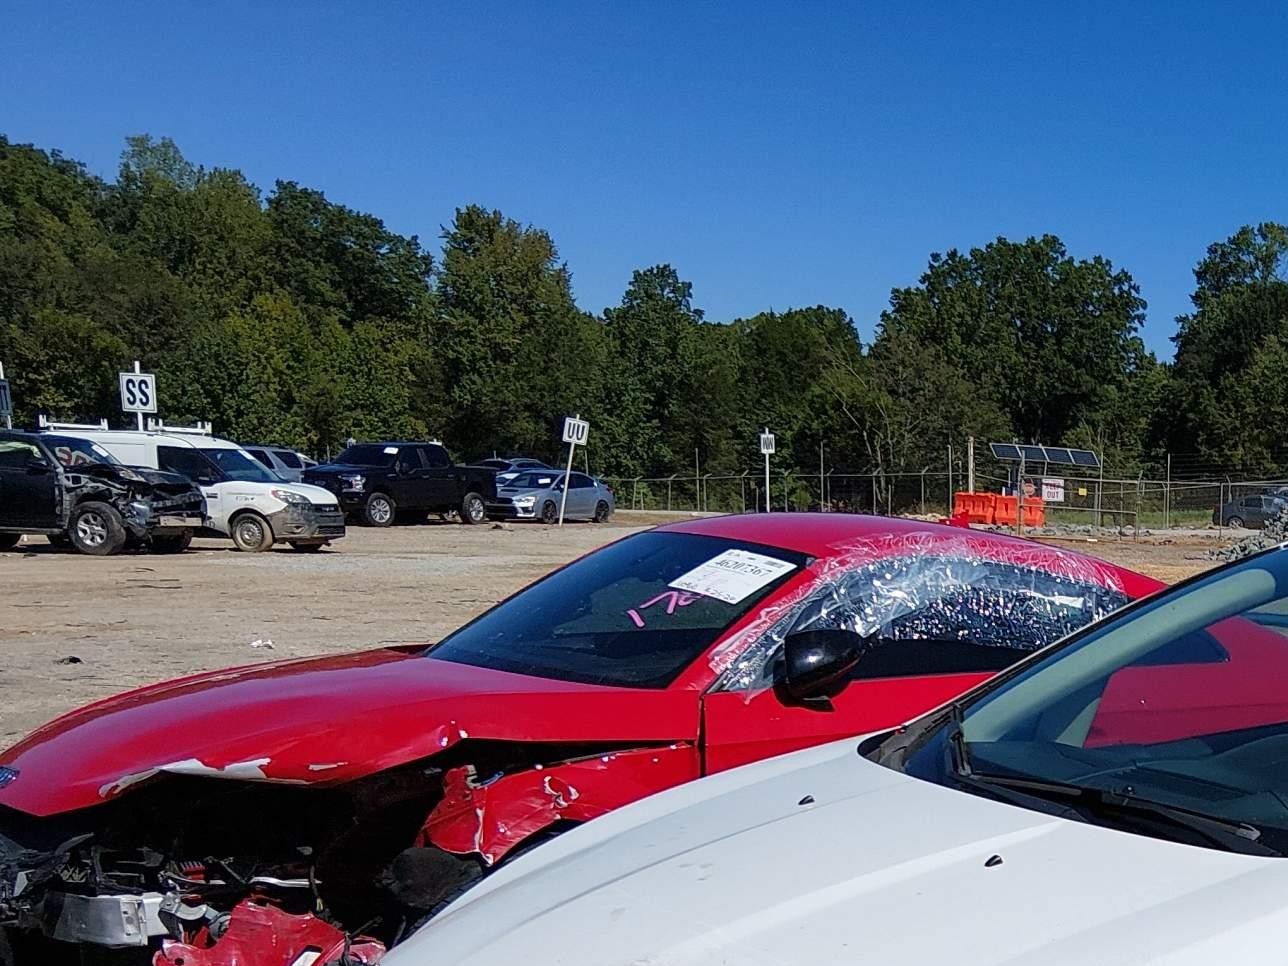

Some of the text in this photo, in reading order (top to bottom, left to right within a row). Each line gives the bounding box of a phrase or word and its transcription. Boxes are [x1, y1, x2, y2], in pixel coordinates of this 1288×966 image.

[126, 378, 150, 406] SS
[567, 421, 586, 441] UU
[1046, 490, 1060, 499] OUT
